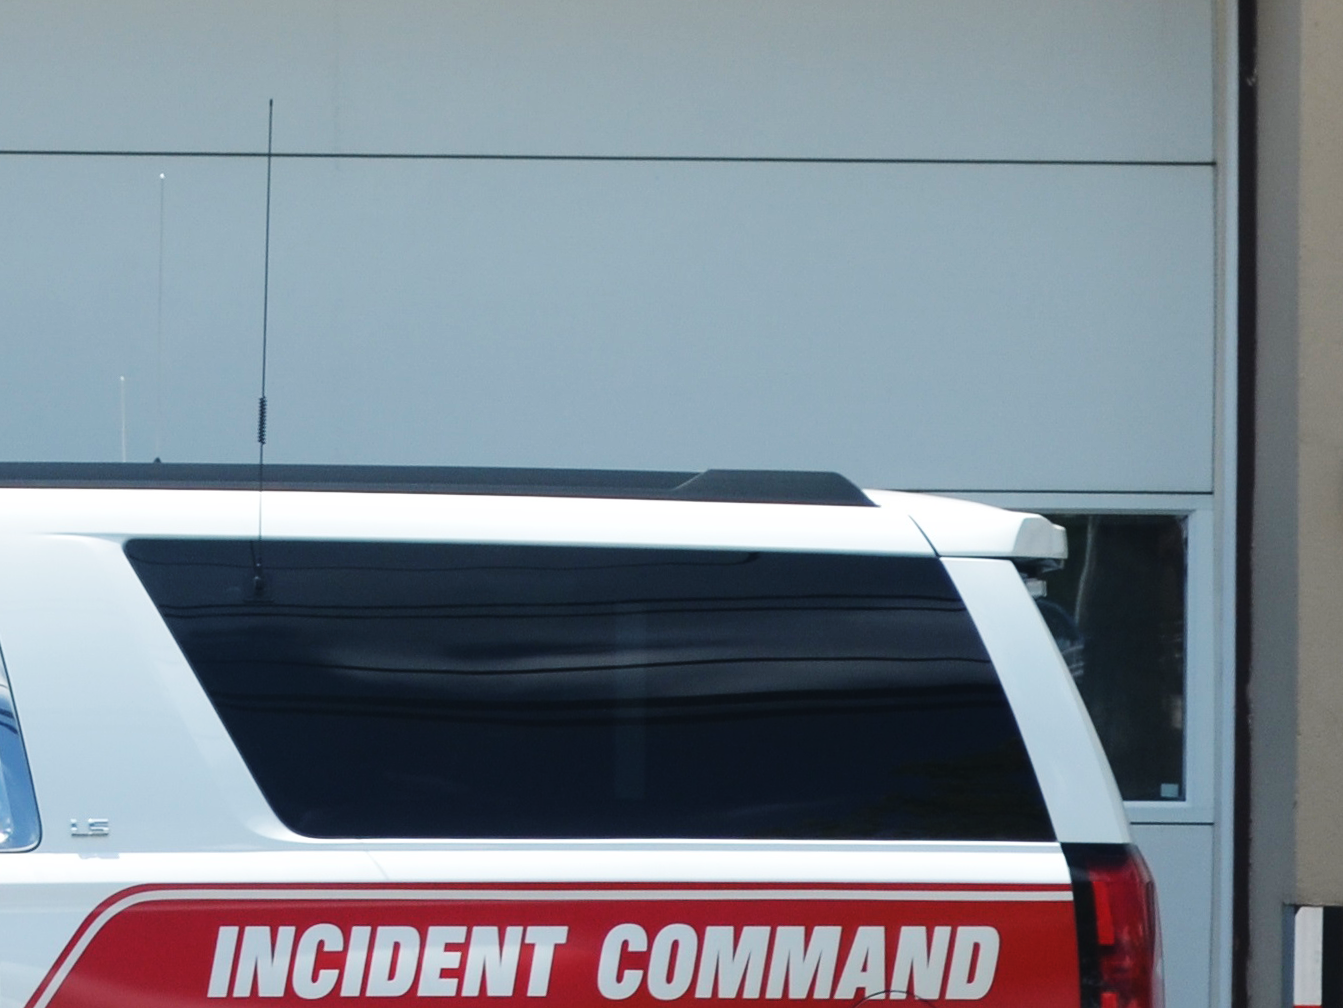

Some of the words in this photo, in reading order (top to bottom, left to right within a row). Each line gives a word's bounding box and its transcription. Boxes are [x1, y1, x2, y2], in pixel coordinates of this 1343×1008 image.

[70, 818, 109, 837] LS
[206, 923, 569, 1000] INCIDENT
[597, 923, 1001, 1001] COMMAND
